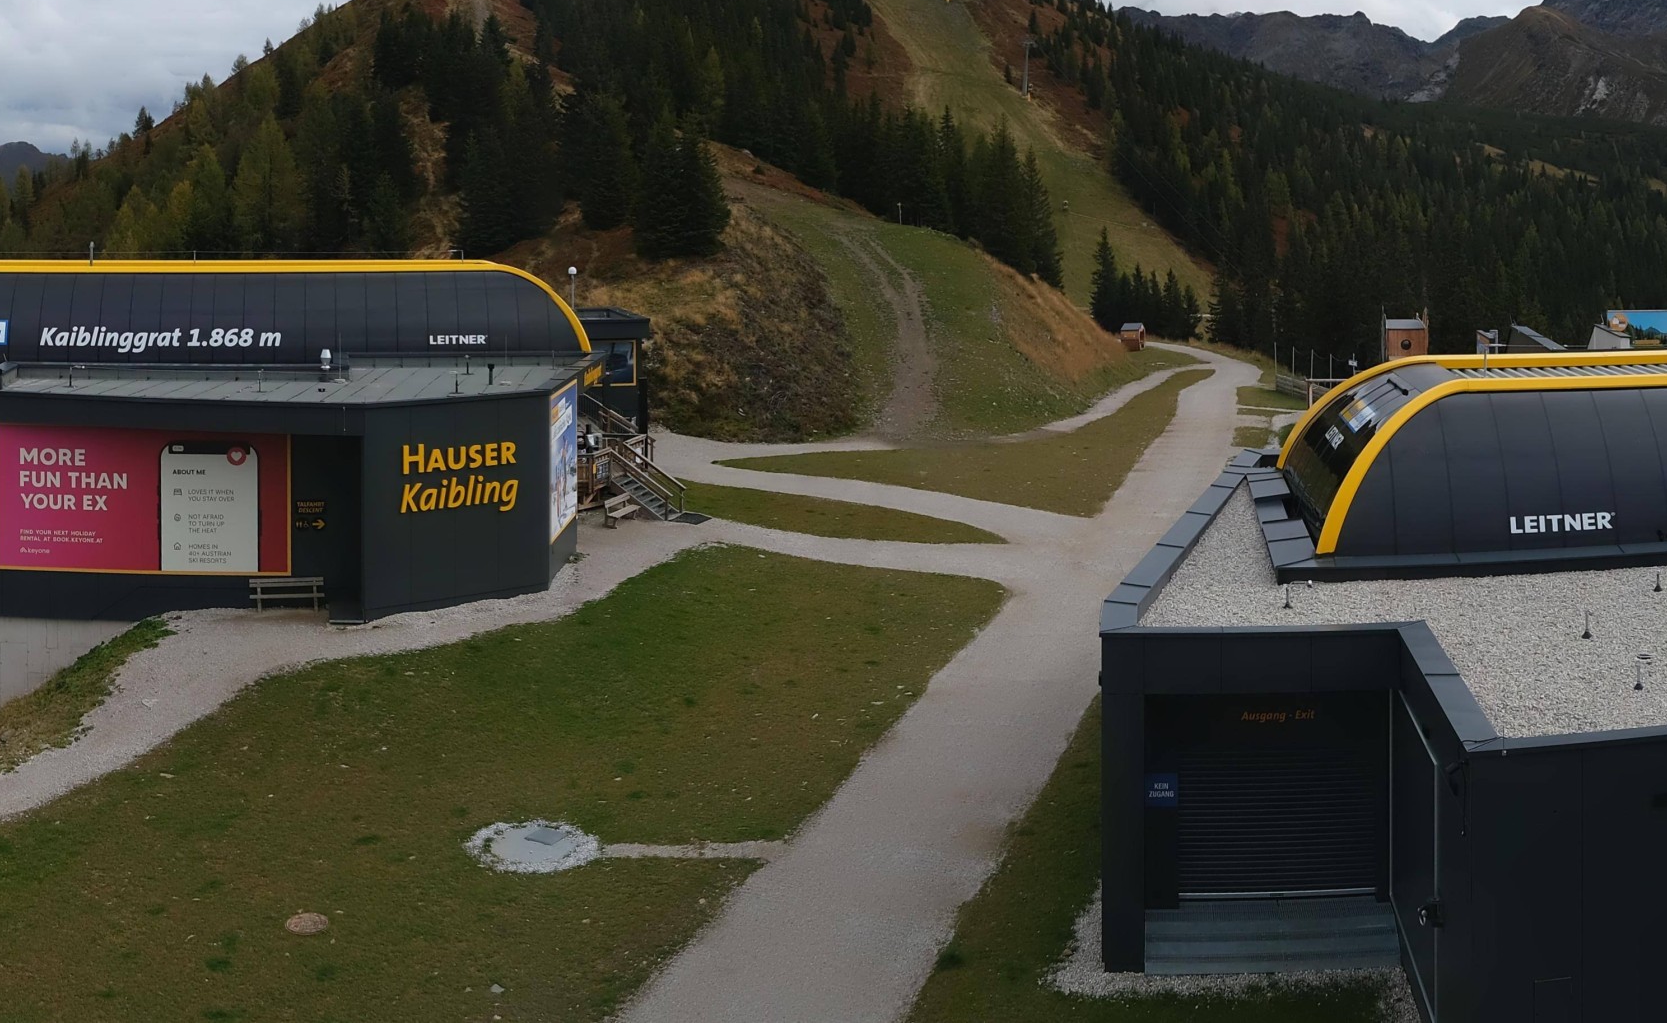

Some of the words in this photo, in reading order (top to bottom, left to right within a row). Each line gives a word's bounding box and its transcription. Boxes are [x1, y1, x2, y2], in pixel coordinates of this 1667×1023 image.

[39, 326, 181, 353] Kaiblinggrat
[187, 328, 254, 347] 1.868
[259, 333, 282, 347] m
[429, 335, 486, 345] LEITNER
[19, 447, 86, 466] MORE
[402, 441, 517, 475] HAUSER
[19, 470, 61, 488] FUN
[68, 472, 128, 489] THAN
[20, 493, 76, 510] YOUR
[83, 495, 108, 511] EX
[400, 475, 519, 514] Kaibling
[1509, 512, 1613, 535] LEITNER
[1241, 711, 1287, 723] Ausgang
[1295, 709, 1315, 719] Exit
[1148, 790, 1174, 798] ZUGANG
